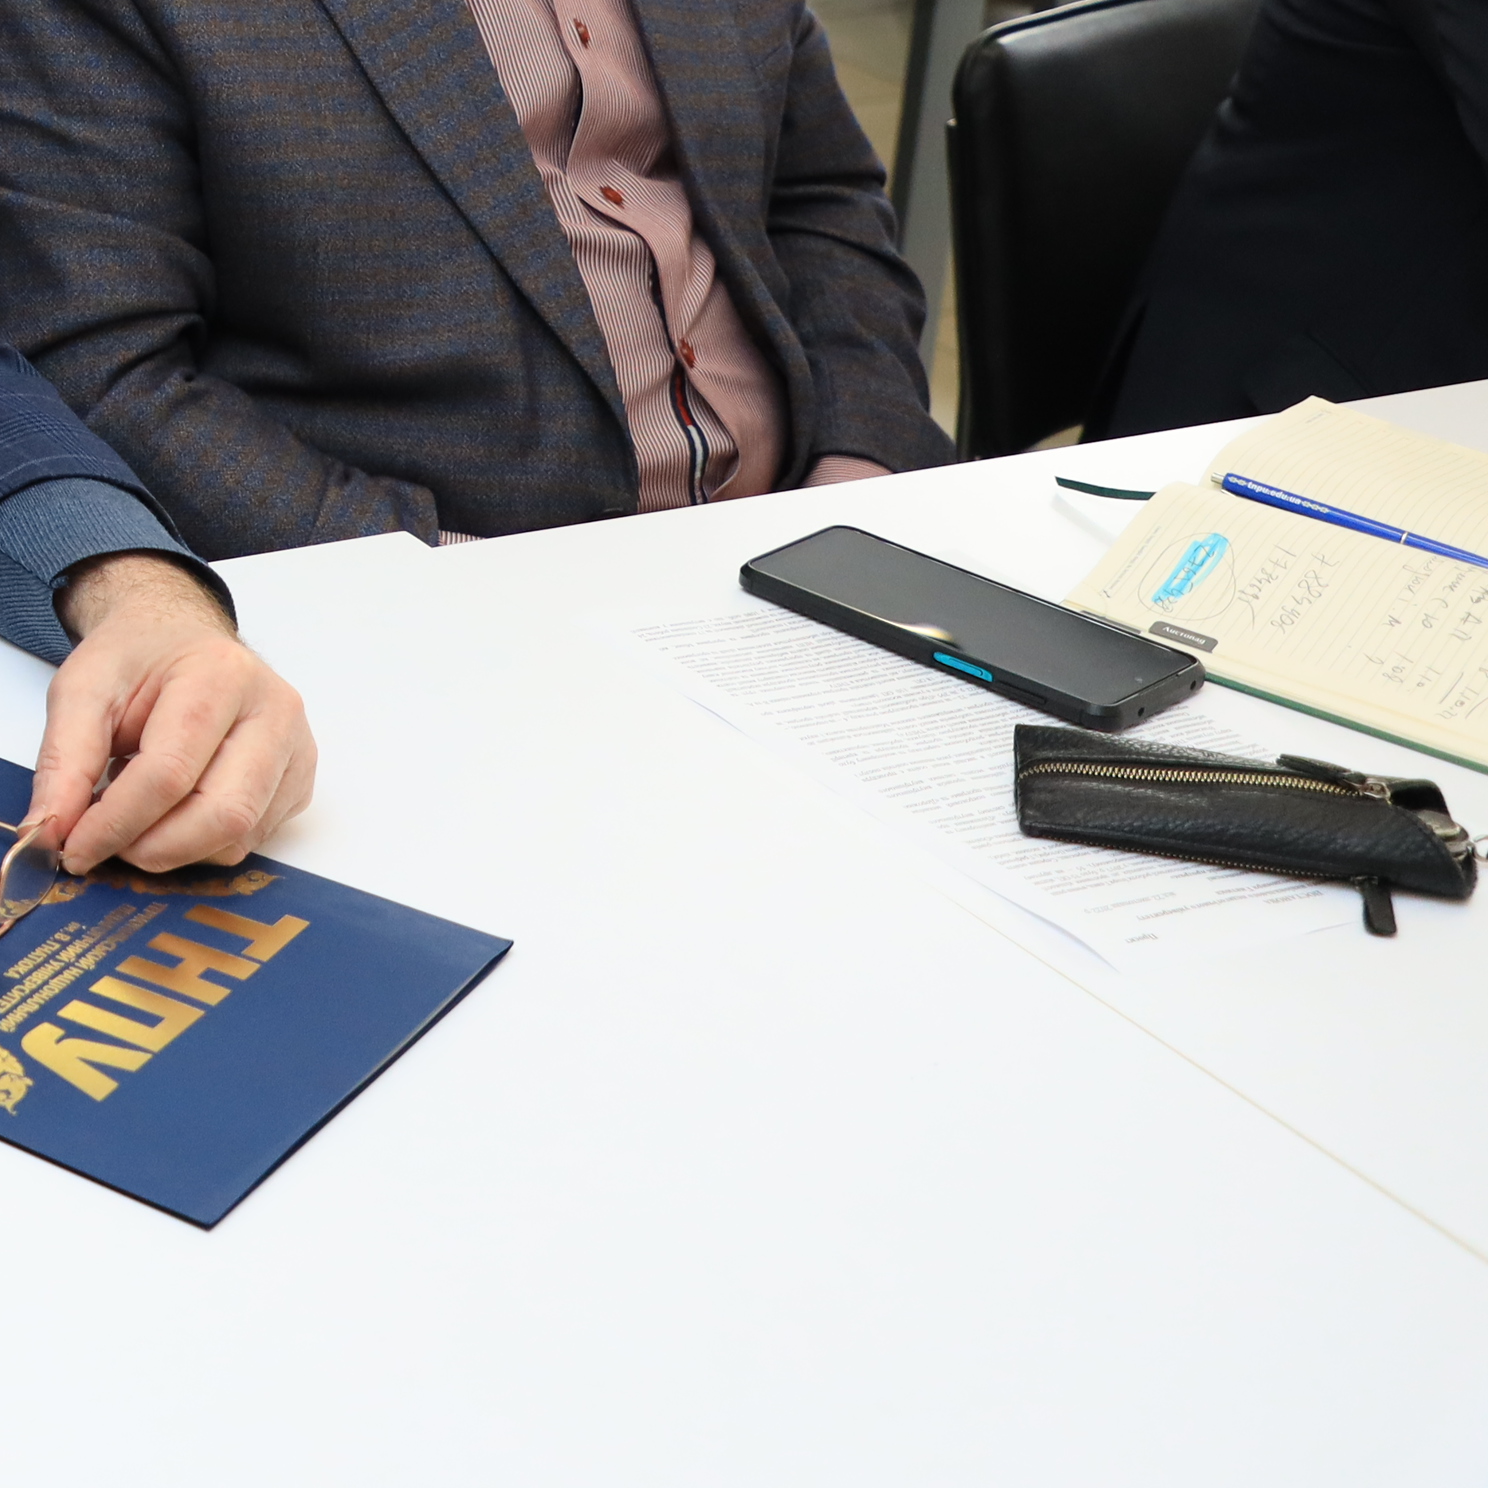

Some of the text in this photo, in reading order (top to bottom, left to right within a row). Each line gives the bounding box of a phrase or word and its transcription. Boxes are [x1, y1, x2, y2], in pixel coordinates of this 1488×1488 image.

[1247, 481, 1302, 506] tnpu.edu.ua
[1161, 626, 1206, 647] Листопад
[3, 938, 61, 979] ГНАТЮКА
[22, 903, 310, 1102] ТНПУ
